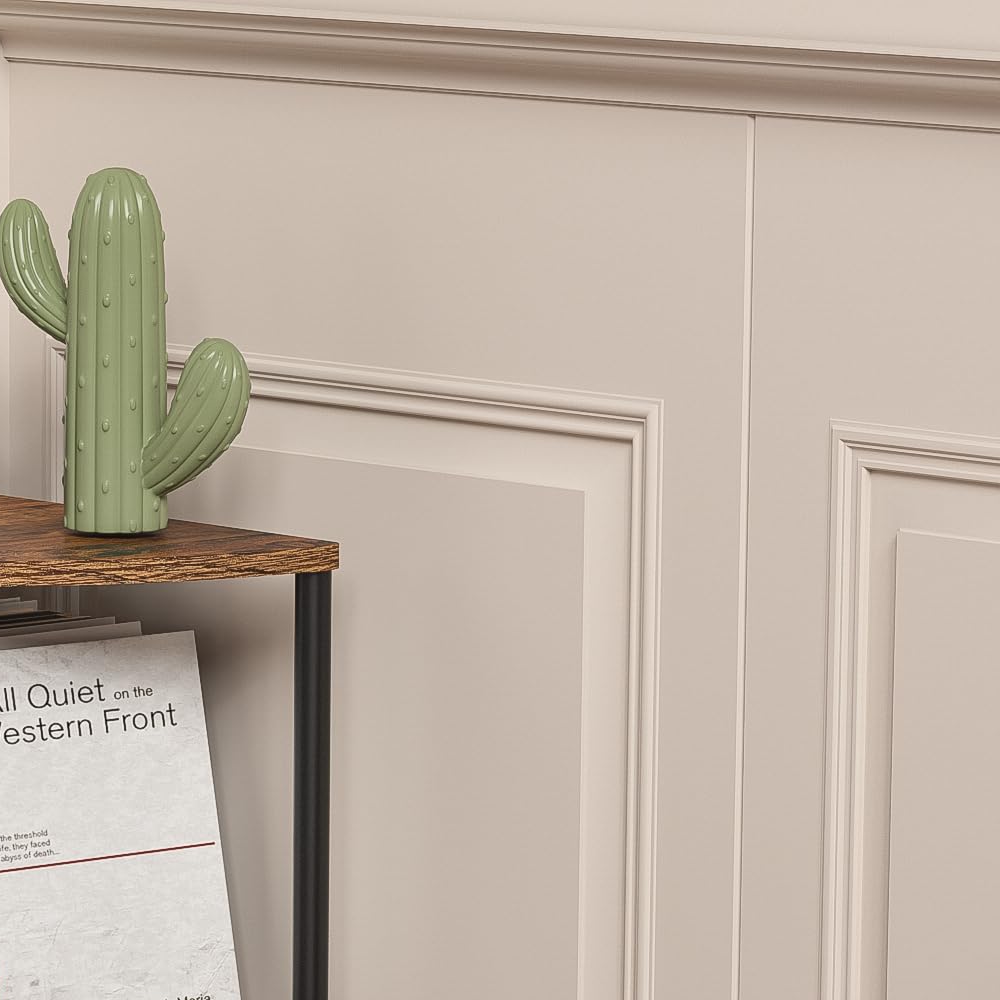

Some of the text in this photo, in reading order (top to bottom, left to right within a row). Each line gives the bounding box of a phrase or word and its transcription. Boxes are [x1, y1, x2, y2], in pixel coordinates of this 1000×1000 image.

[27, 678, 106, 709] Quiet
[114, 689, 129, 700] on
[133, 686, 153, 699] the
[103, 702, 177, 734] Front
[14, 830, 48, 840] threshold
[13, 843, 28, 851] they
[31, 839, 51, 848] faced
[0, 854, 21, 863] abyss
